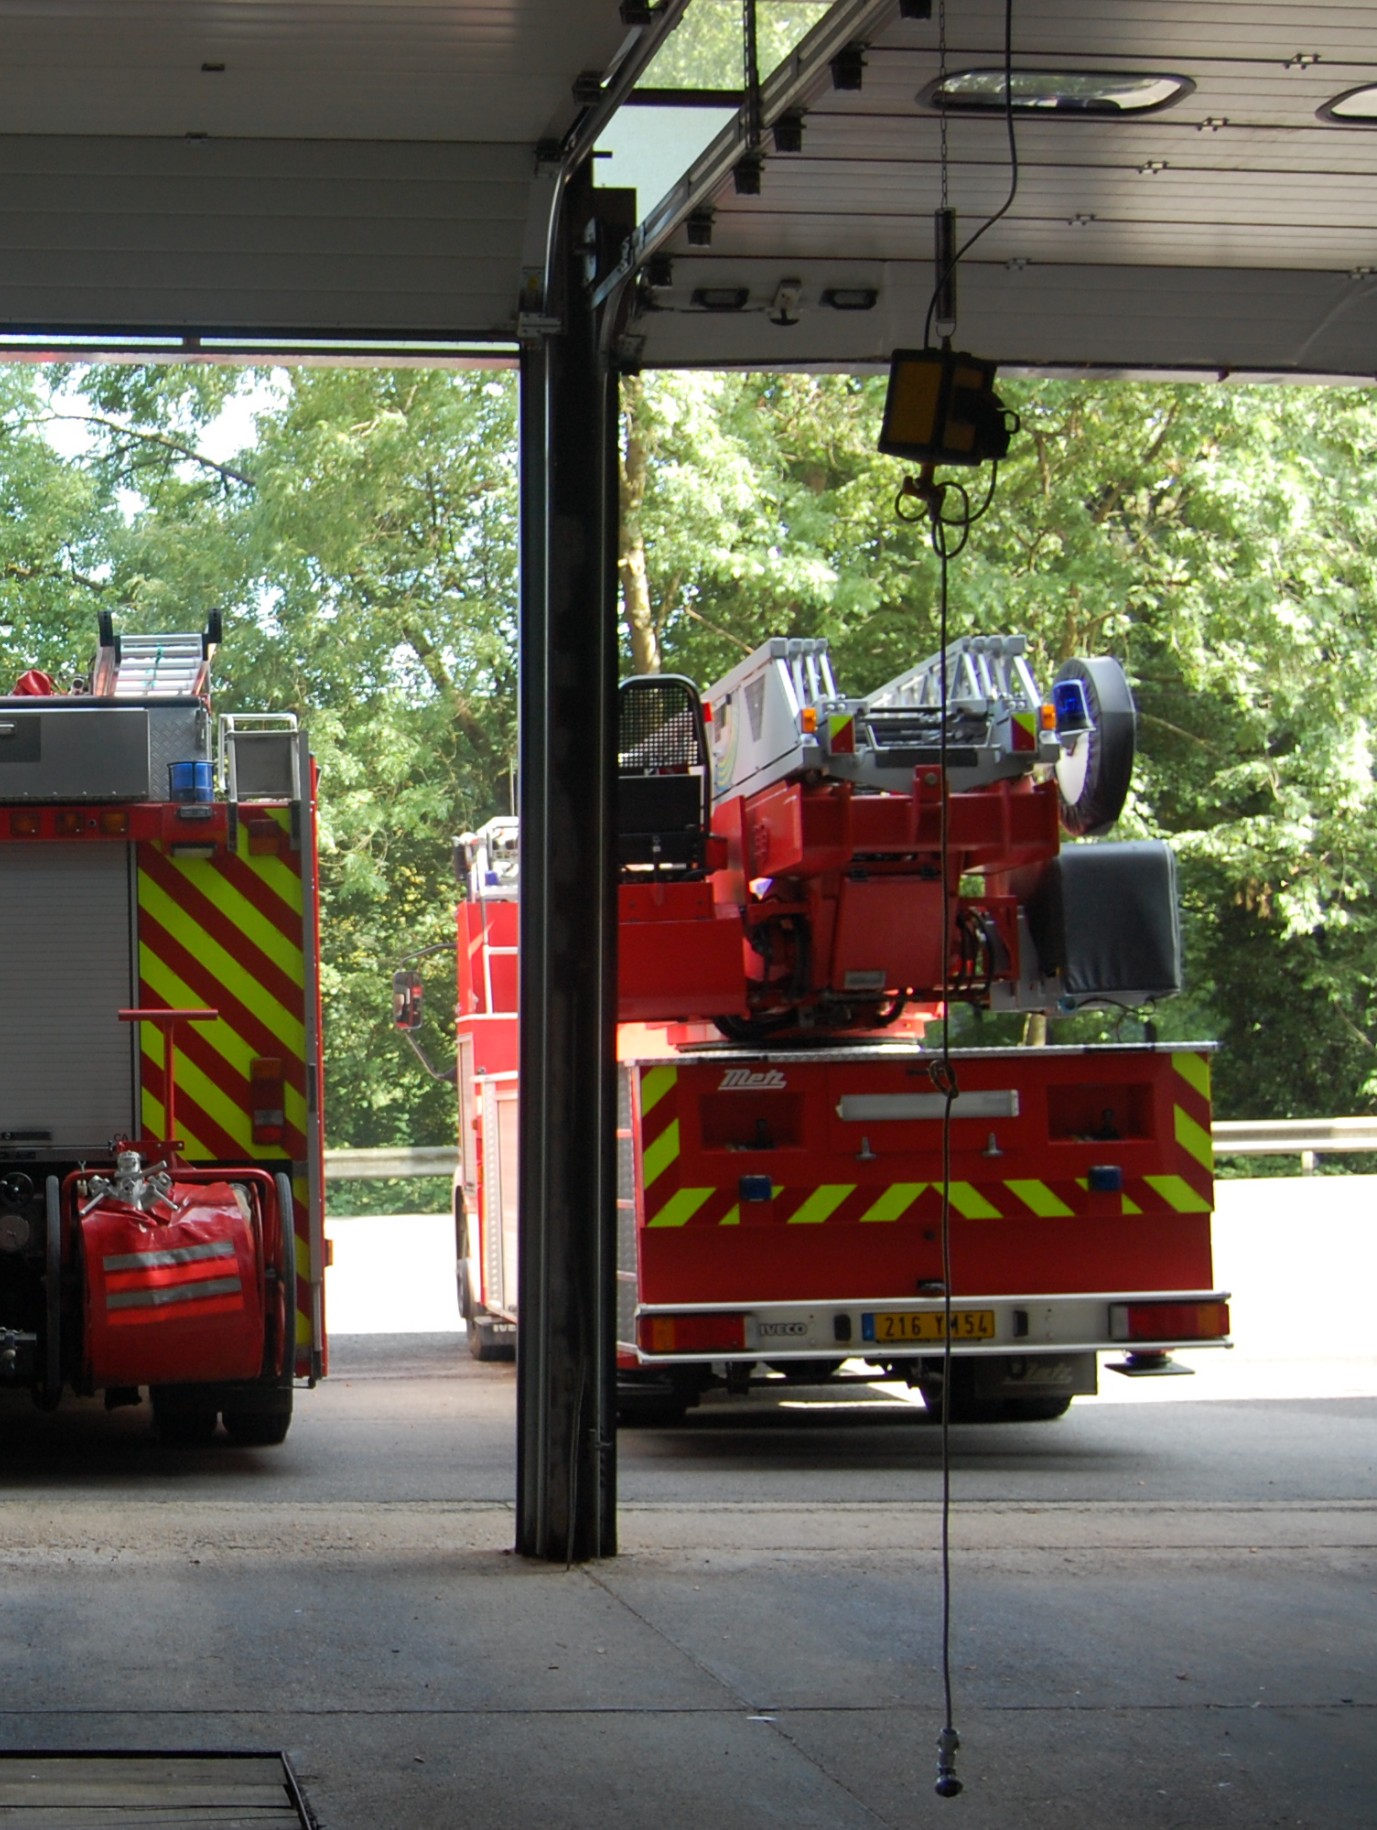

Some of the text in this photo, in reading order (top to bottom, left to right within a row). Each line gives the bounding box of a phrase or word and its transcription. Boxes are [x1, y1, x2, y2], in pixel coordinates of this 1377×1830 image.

[717, 1069, 787, 1090] Metz
[759, 1322, 807, 1336] IVECO
[885, 1316, 921, 1337] 216
[965, 1314, 988, 1334] 54
